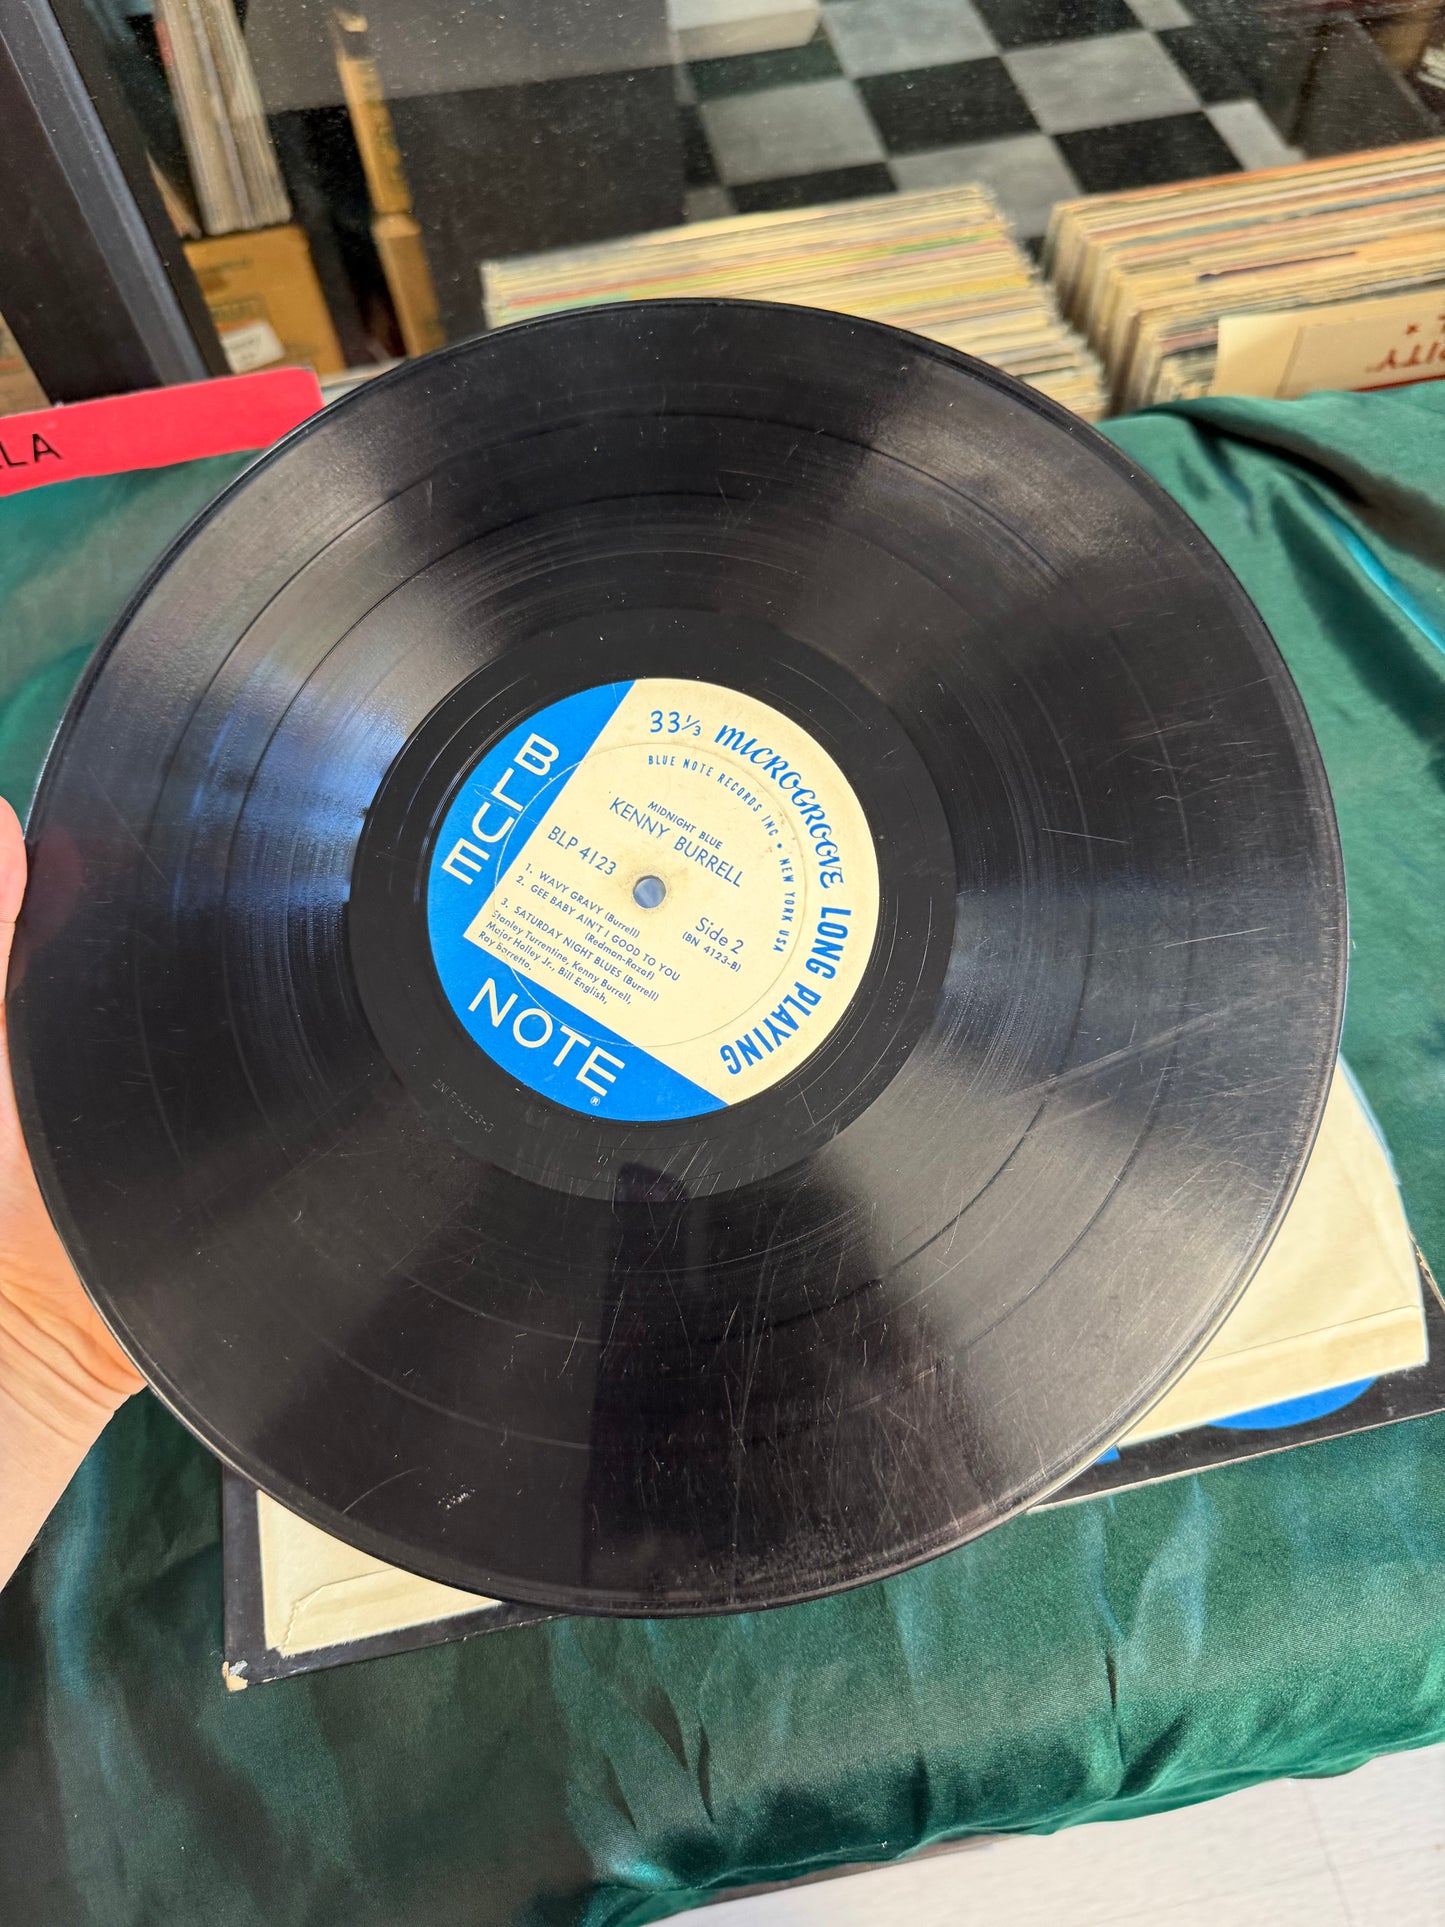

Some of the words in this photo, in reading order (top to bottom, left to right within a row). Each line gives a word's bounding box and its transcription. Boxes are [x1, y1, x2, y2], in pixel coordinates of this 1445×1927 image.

[1365, 340, 1445, 374] ITY
[0, 433, 62, 469] LA
[648, 755, 676, 766] BLUE
[683, 758, 714, 776] NOTE
[441, 732, 560, 886] BLUE
[717, 773, 762, 812] RECORDS
[609, 797, 670, 839] KENNY
[673, 836, 742, 888] BURRELL
[648, 801, 696, 834] MIDNIGHT
[699, 831, 724, 850] BLUE
[761, 815, 778, 836] INC
[548, 826, 578, 850] BLP
[579, 847, 617, 876] 4123
[779, 858, 794, 883] NEW
[525, 863, 533, 873] 1.
[539, 871, 570, 893] WAVY
[570, 891, 604, 914] GRAVY
[604, 912, 640, 939] (Burrell)
[781, 891, 795, 922] YORK
[478, 931, 496, 947] Ray
[496, 943, 532, 971] Barretto.
[500, 897, 509, 908] 3.
[514, 906, 563, 940] SATURDAY
[562, 936, 594, 960] NIGHT
[594, 956, 622, 978] BLUES
[623, 974, 659, 1001] (Burrell)
[515, 875, 525, 886] 2.
[530, 884, 549, 900] GEE
[549, 896, 576, 916] BABY
[576, 913, 604, 933] AIN'T
[604, 930, 610, 938] I
[611, 934, 641, 957] GOOD
[642, 953, 656, 966] TO
[658, 963, 681, 981] YOU
[682, 931, 701, 948] (BN
[703, 946, 742, 973] 4123-B)
[695, 917, 729, 947] Side
[730, 940, 744, 954] 2
[773, 929, 790, 952] USA
[805, 906, 852, 980] LONG
[486, 921, 513, 941] Major
[512, 938, 541, 961] Holley
[558, 967, 574, 981] Bill
[574, 977, 607, 1005] English,
[492, 910, 524, 935] Stanley
[525, 930, 569, 966] Turrentine,
[571, 961, 600, 984] Kenny
[600, 978, 631, 1005] Burrell,
[584, 932, 655, 980] (Redman-Razaf)
[468, 977, 626, 1097] NOTE
[720, 981, 822, 1075] PLAYING
